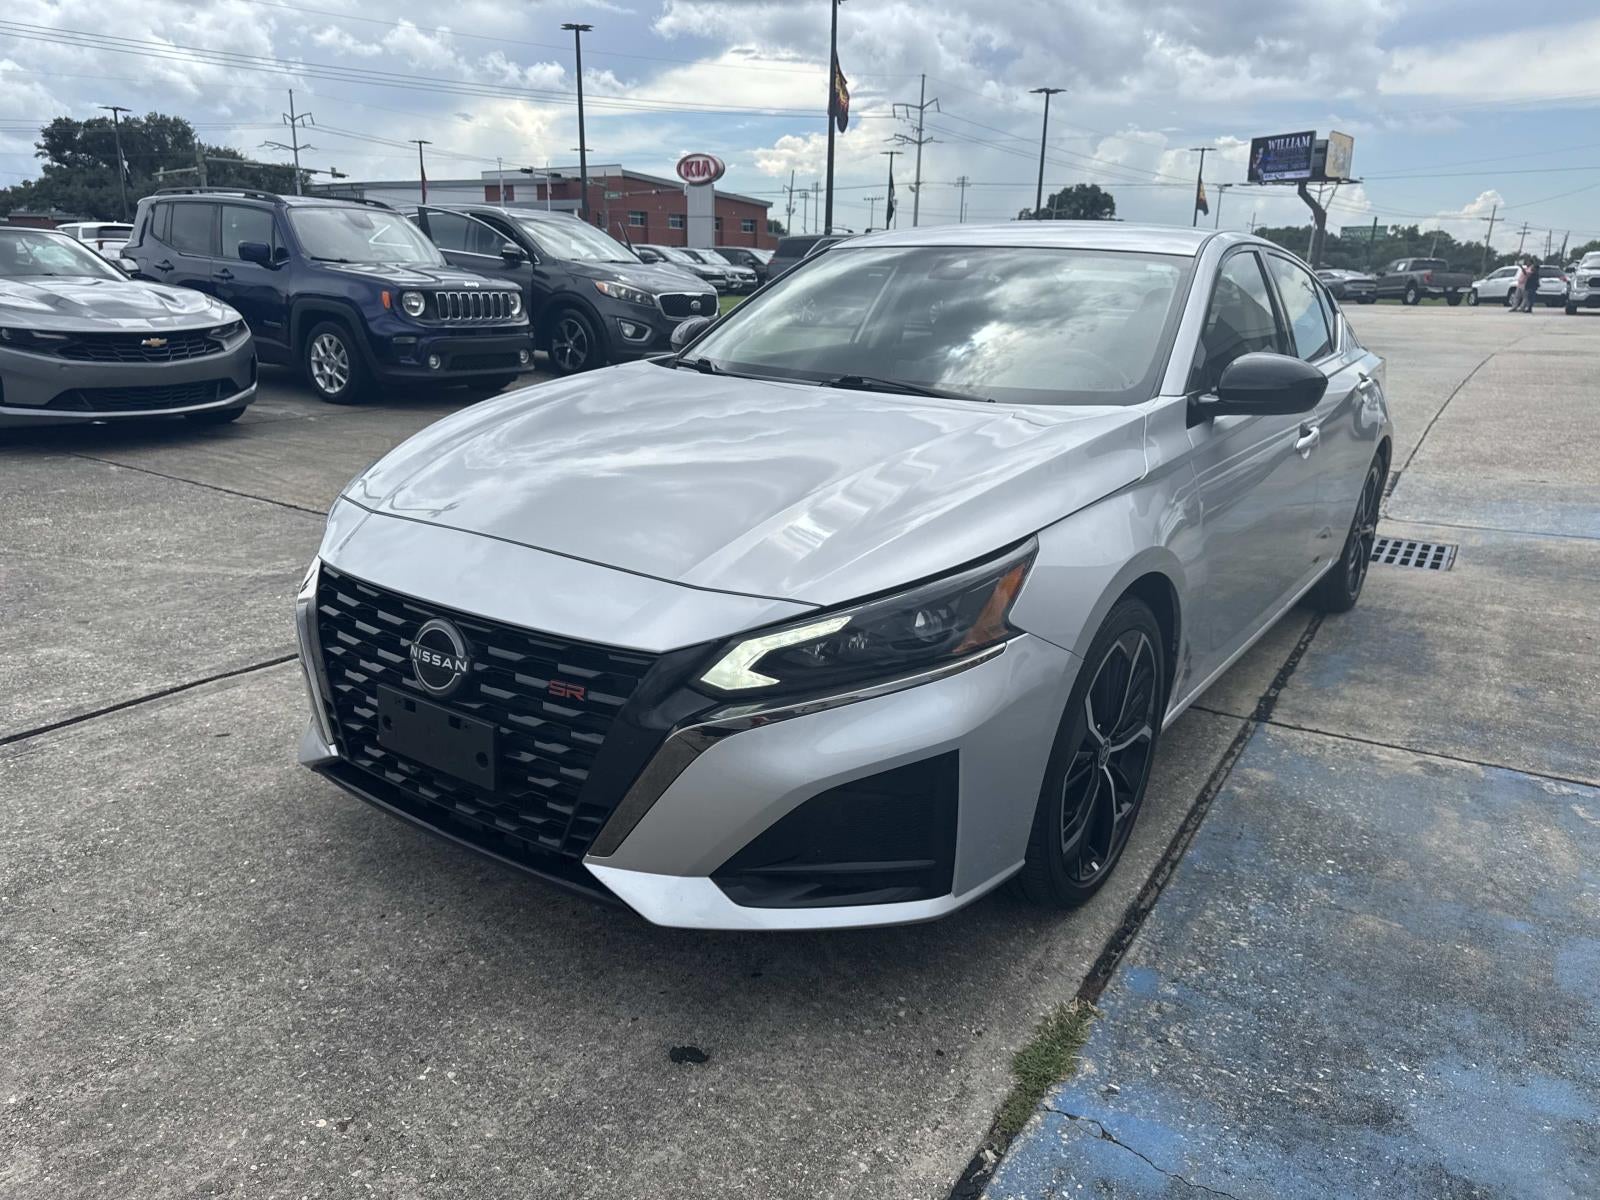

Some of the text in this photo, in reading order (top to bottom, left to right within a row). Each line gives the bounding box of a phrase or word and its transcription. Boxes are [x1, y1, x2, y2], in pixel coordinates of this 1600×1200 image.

[683, 160, 712, 177] KIA
[409, 644, 468, 672] NISSAN
[549, 679, 585, 701] SR
